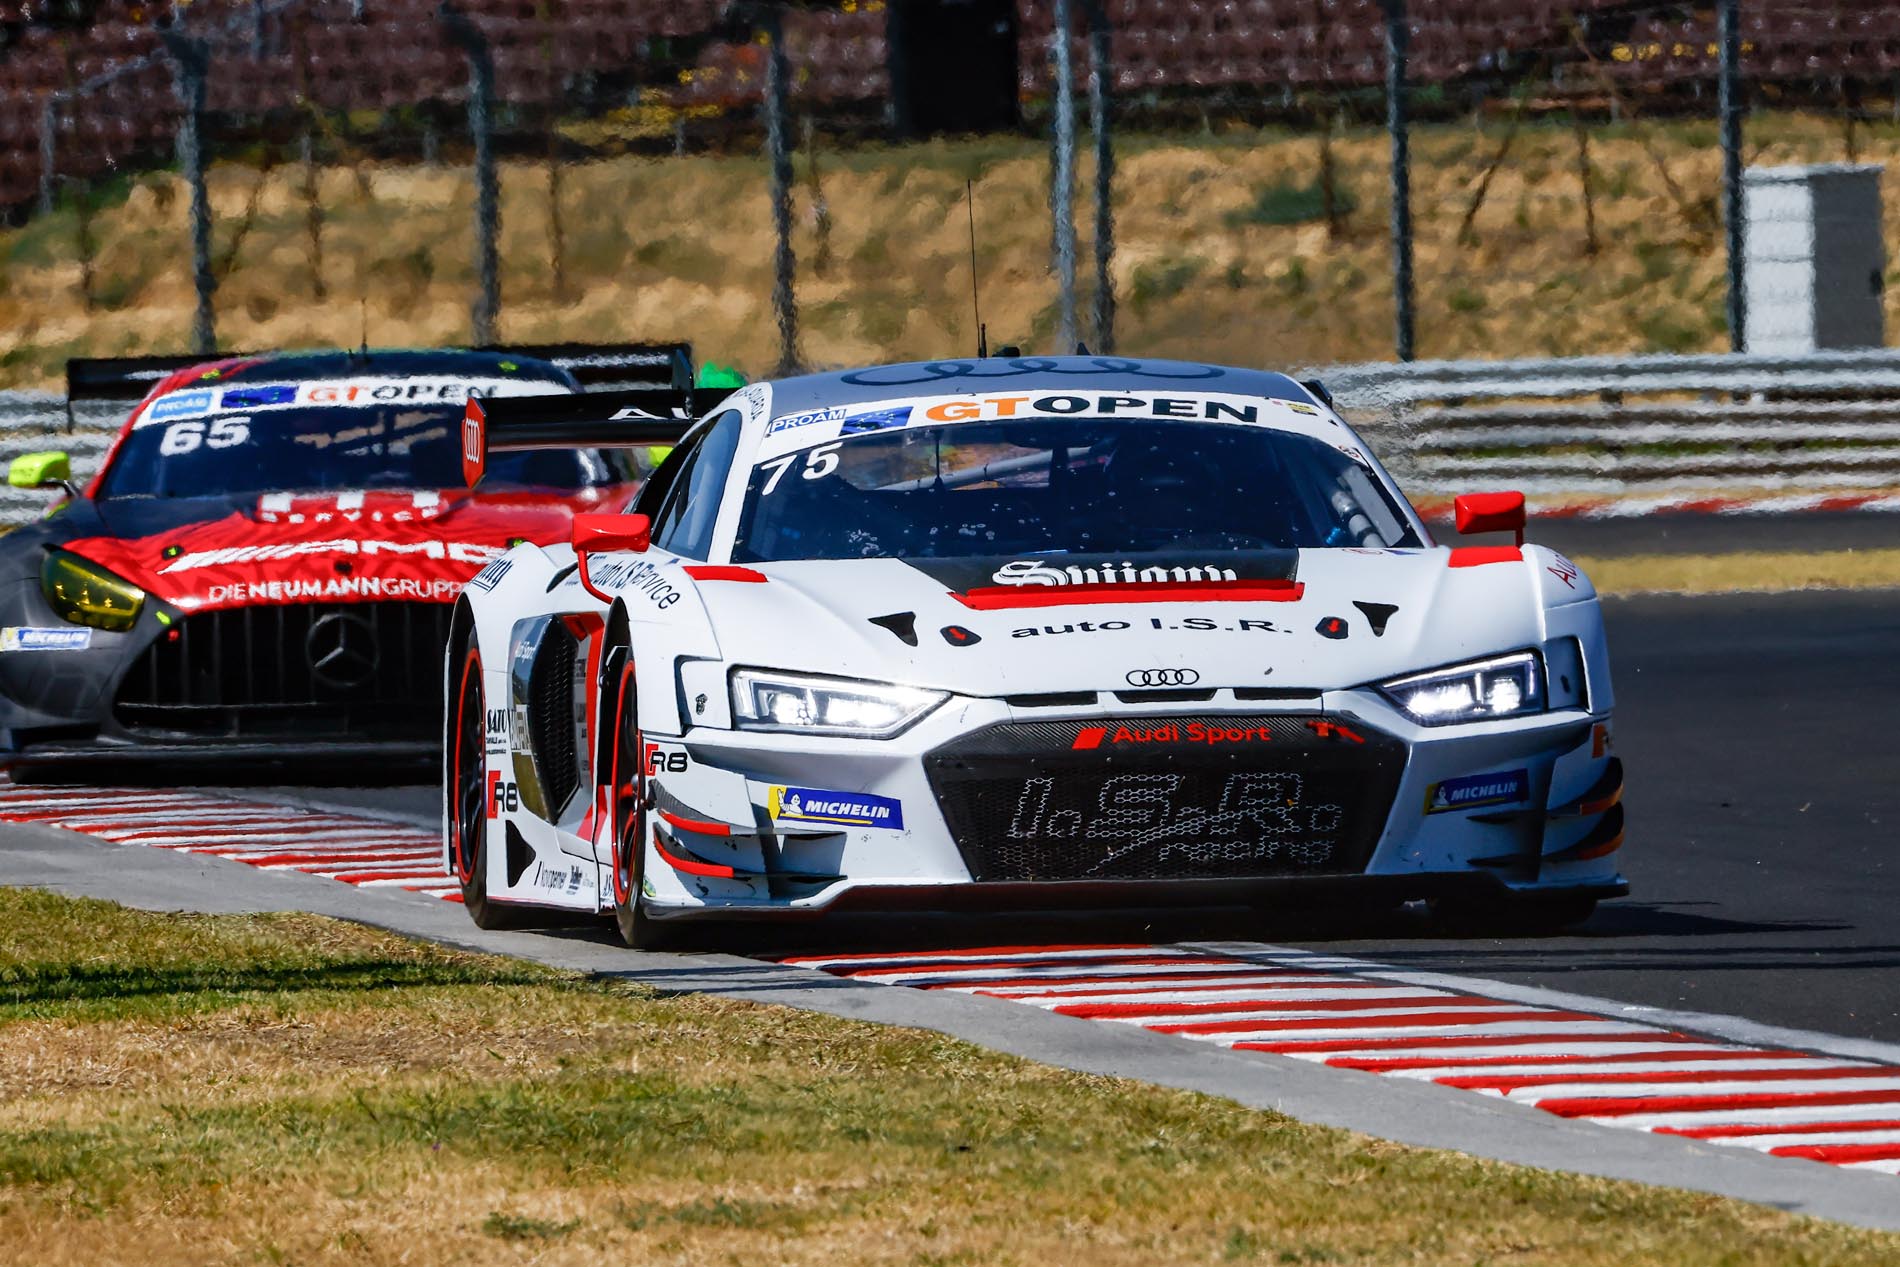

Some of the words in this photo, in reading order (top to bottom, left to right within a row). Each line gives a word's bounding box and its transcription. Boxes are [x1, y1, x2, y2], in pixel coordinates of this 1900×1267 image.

[770, 408, 846, 433] PROAM
[160, 416, 251, 456] 65
[761, 441, 844, 496] 75
[1012, 621, 1131, 639] auto
[1150, 617, 1293, 634] I.S.R.
[1112, 724, 1179, 744] Audi
[1187, 722, 1271, 746] Sport
[650, 751, 688, 773] R8
[494, 782, 518, 813] R8
[1451, 781, 1518, 801] MICHELIN
[805, 799, 890, 819] MICHELIN
